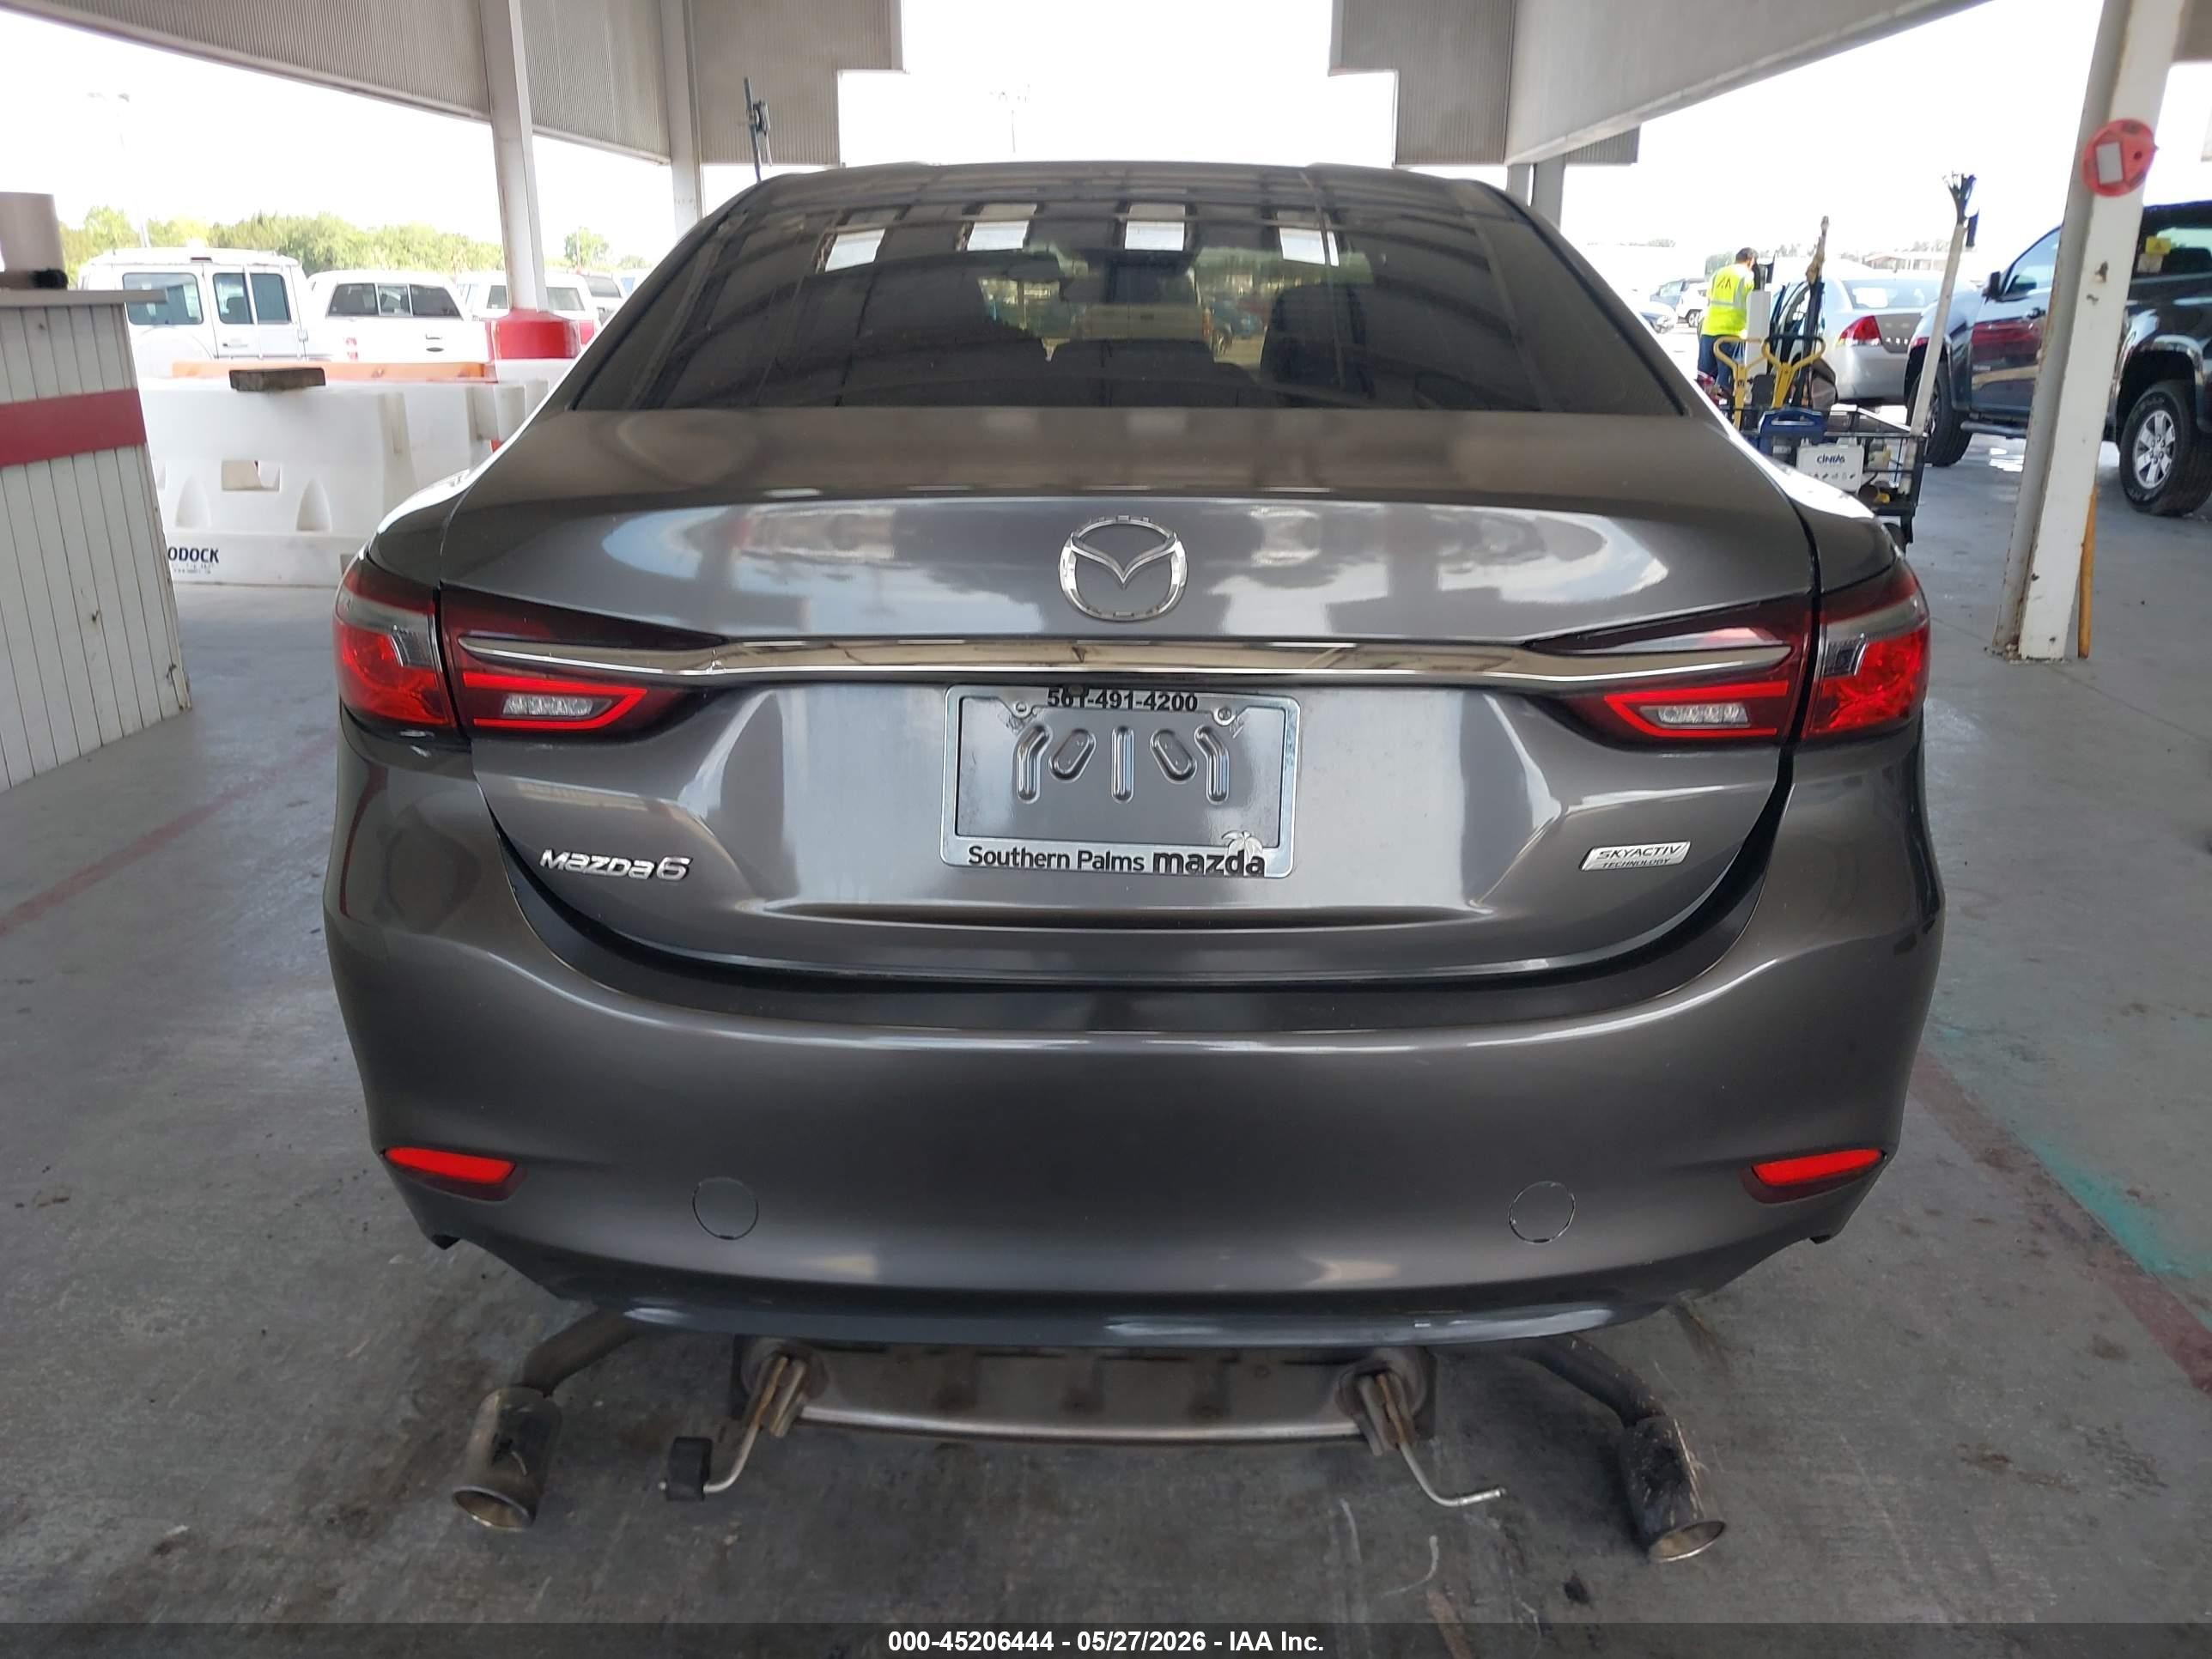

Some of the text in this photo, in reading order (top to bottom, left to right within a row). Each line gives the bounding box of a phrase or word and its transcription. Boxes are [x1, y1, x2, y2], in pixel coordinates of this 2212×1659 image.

[167, 546, 220, 563] ODOCK
[1596, 844, 1682, 860] SKYACTIV
[968, 845, 1265, 877] Southern Palms mazda
